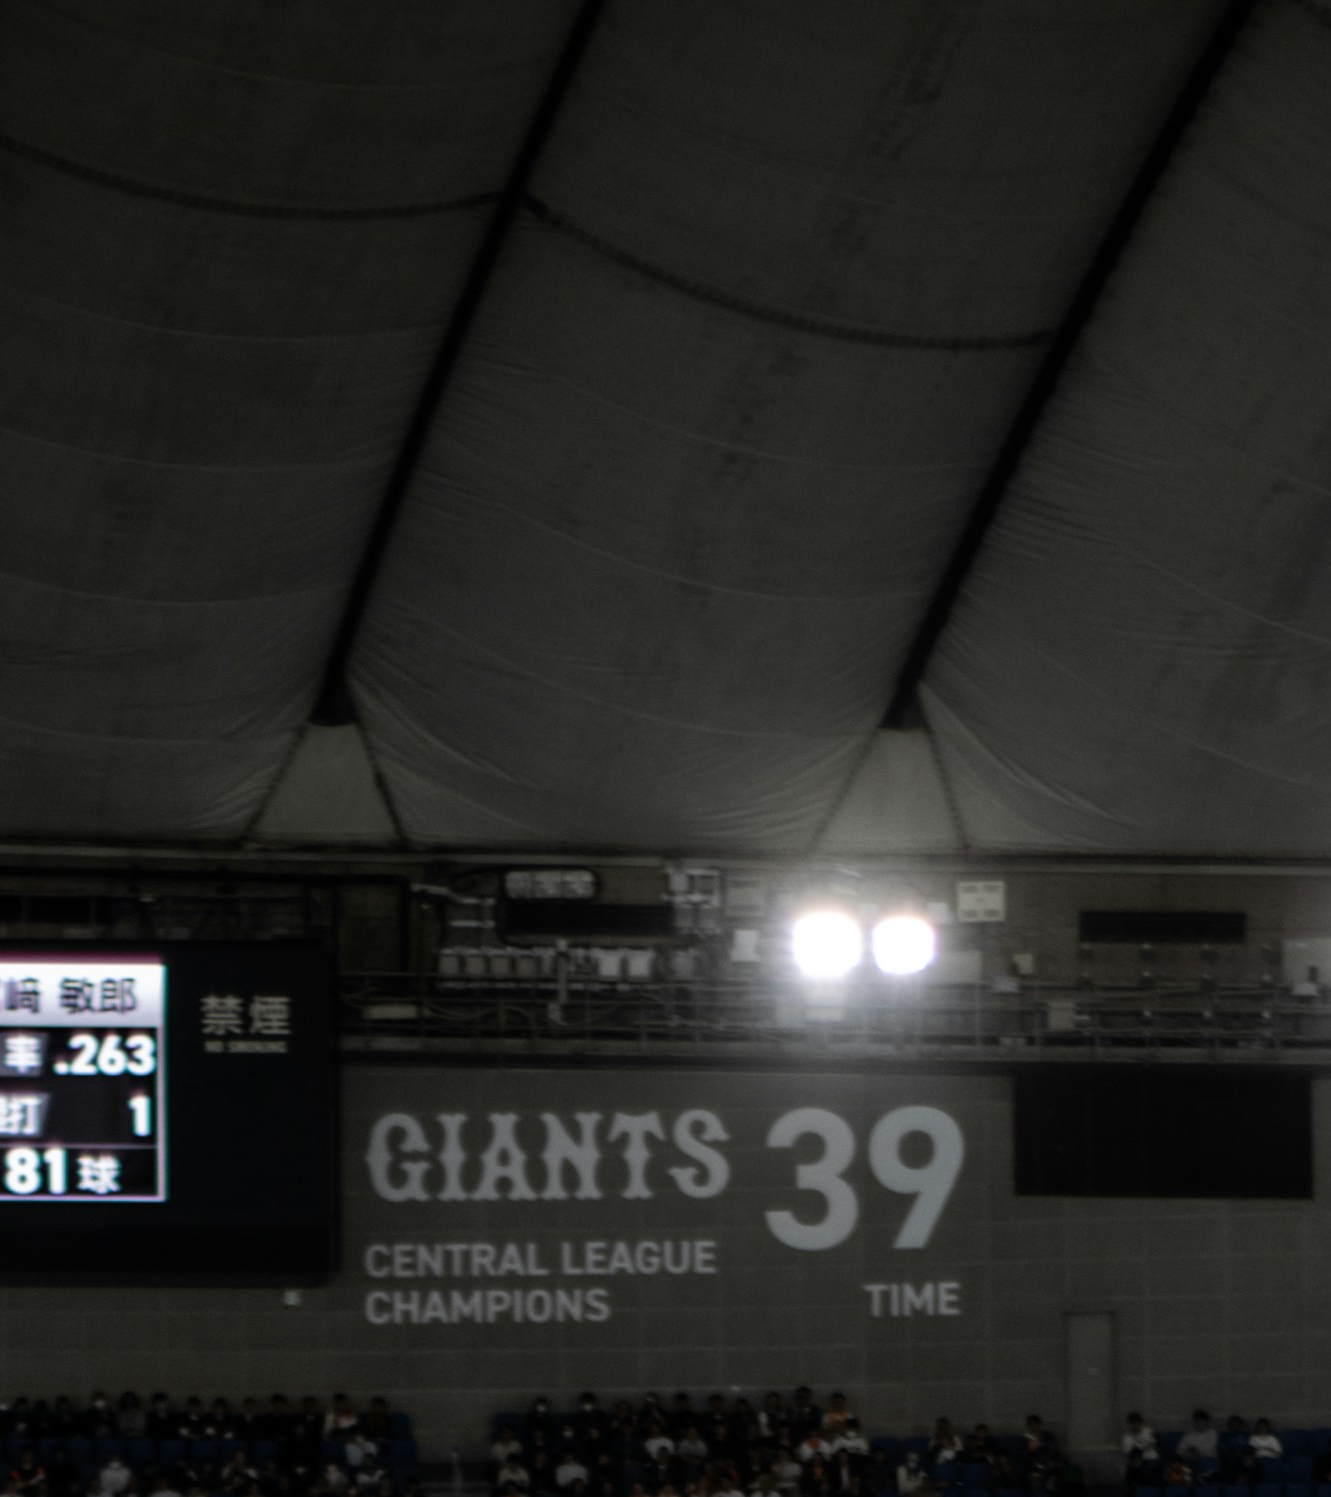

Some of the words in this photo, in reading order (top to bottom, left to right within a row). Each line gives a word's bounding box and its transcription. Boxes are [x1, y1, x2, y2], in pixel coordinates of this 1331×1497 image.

[200, 995, 292, 1036] 禁煙
[53, 1034, 158, 1077] .263
[128, 1095, 152, 1138] 1
[365, 1108, 732, 1201] GIANTS
[764, 1105, 964, 1252] 39
[365, 1241, 549, 1279] CENTRAL
[562, 1240, 717, 1276] LEAGUE
[365, 1288, 611, 1325] CHAMPIONS
[863, 1282, 961, 1319] TIME
